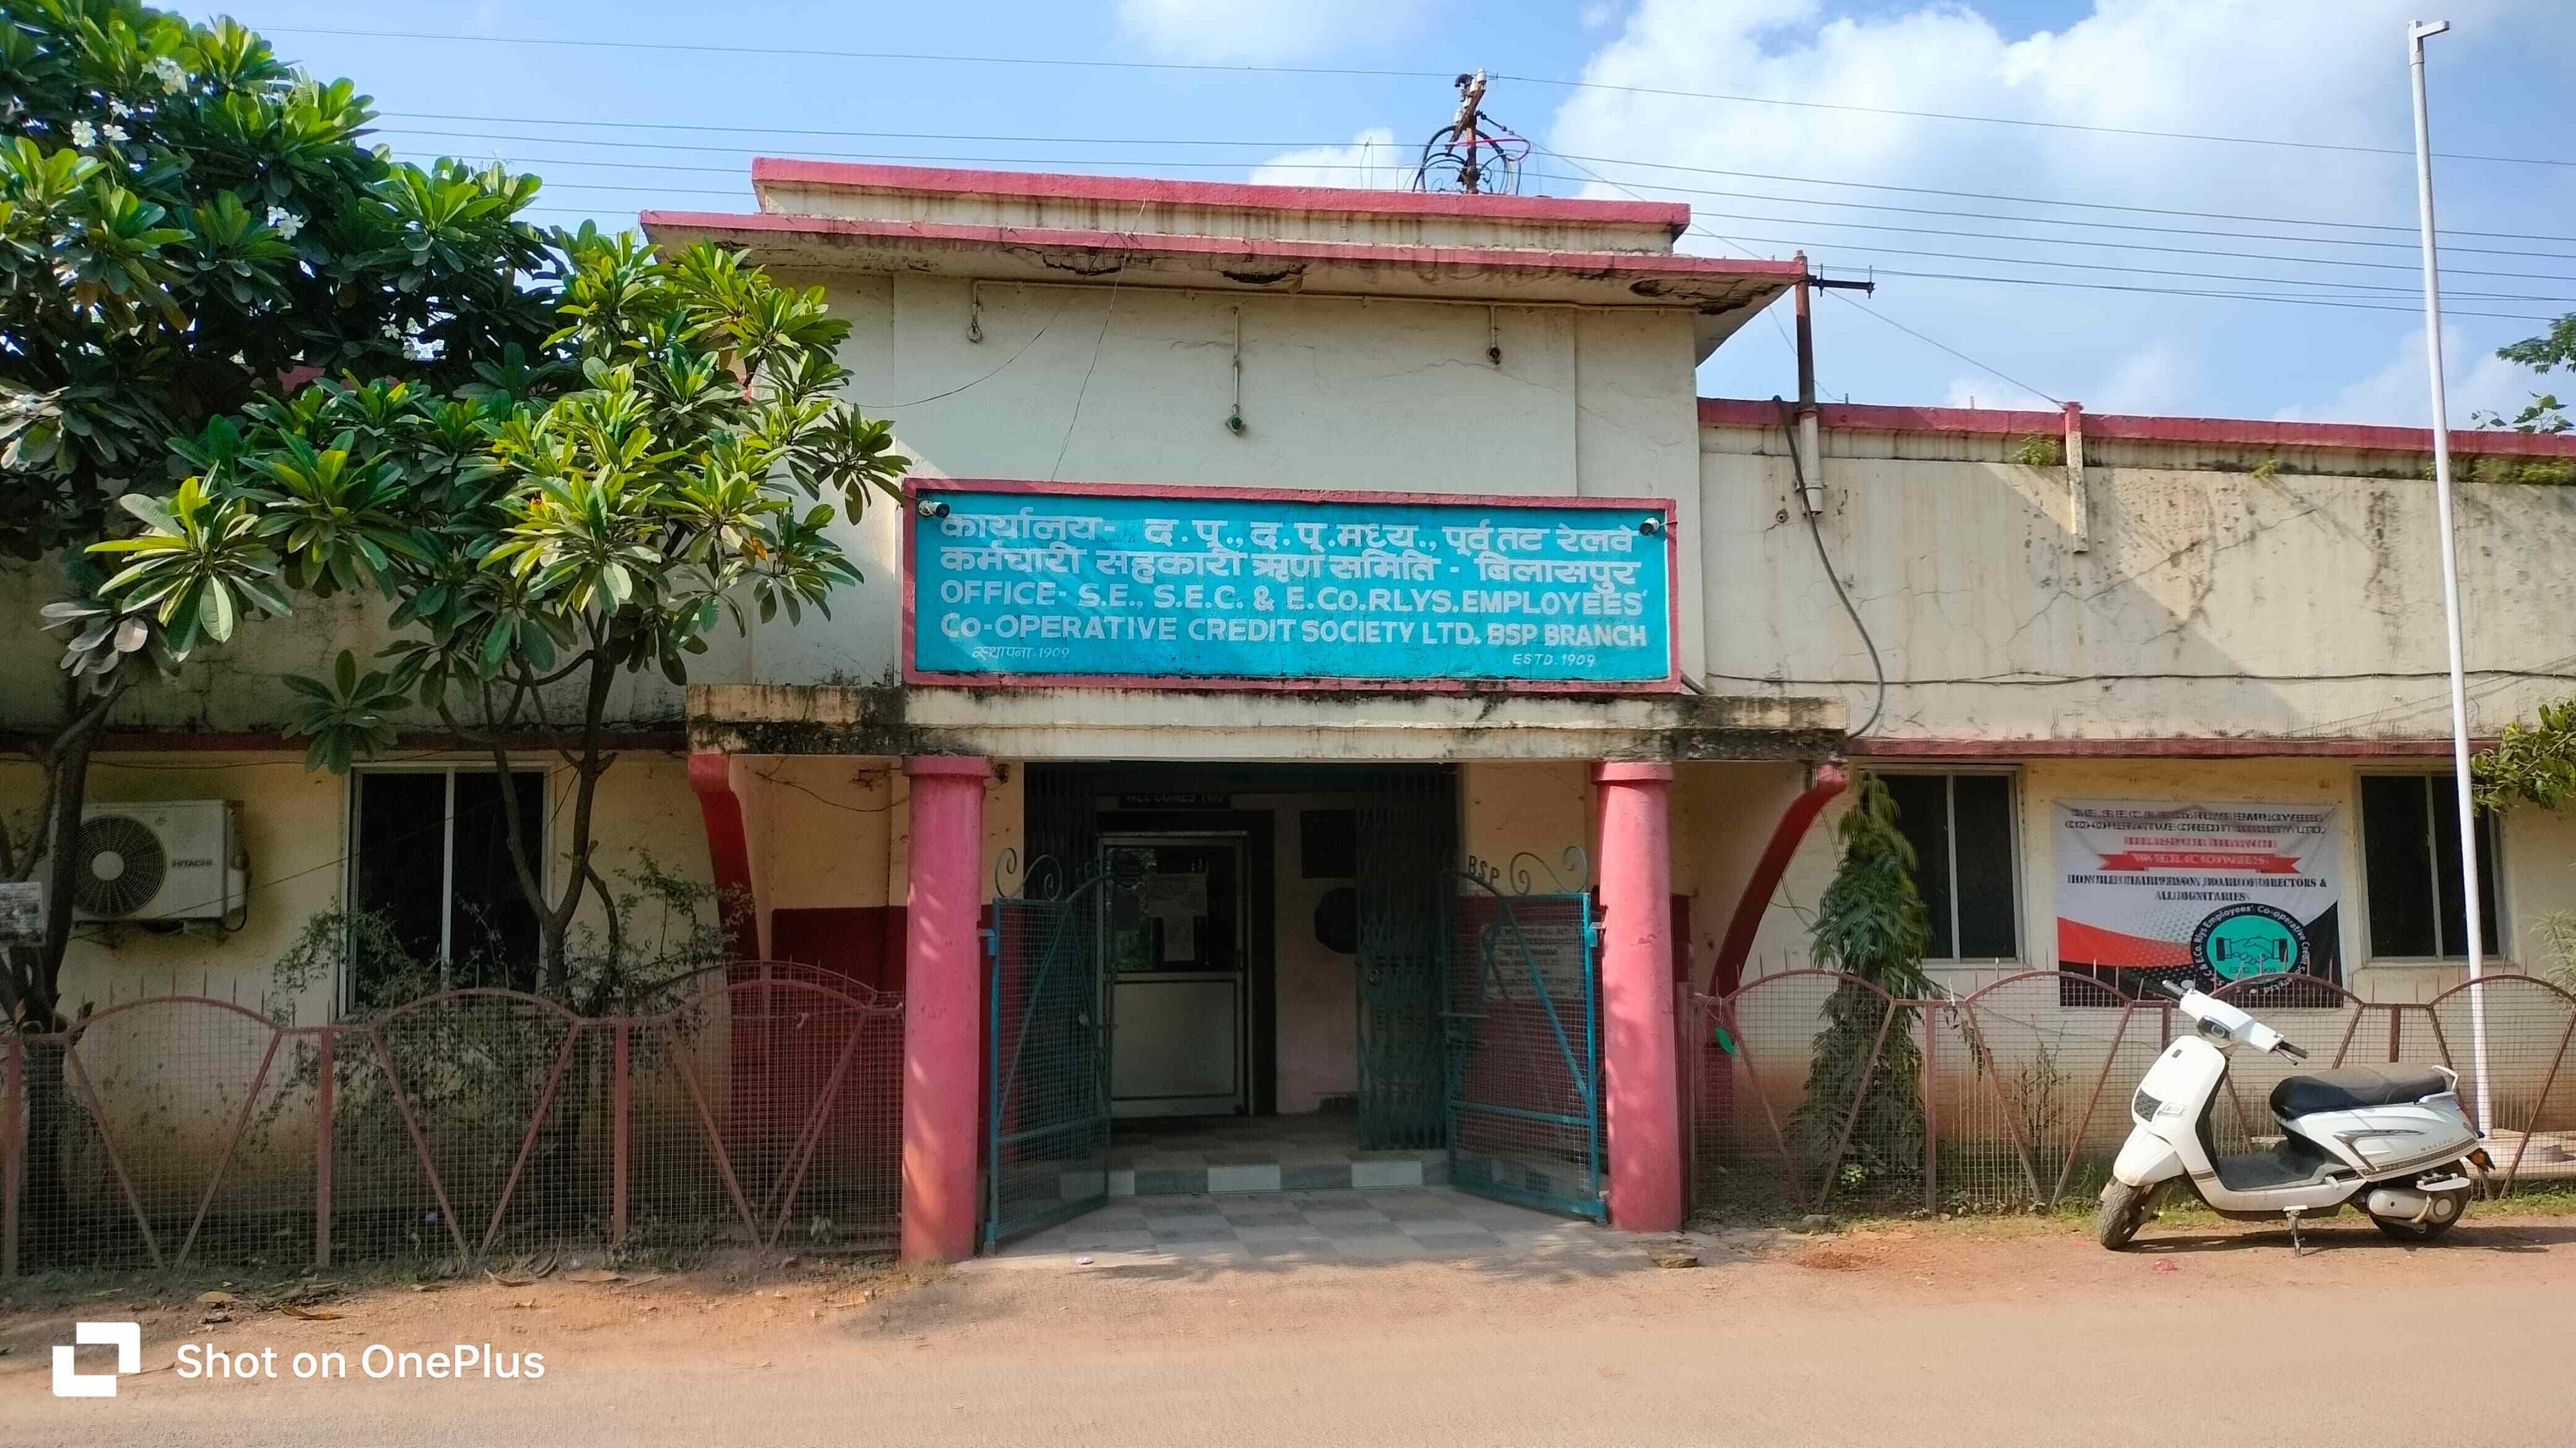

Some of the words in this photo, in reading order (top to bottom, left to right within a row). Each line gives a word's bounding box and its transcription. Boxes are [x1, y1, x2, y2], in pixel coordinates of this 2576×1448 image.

[1497, 527, 1550, 551] तट
[1556, 522, 1639, 552] रेलवे
[940, 540, 1087, 573] कर्मचारी
[1095, 547, 1248, 584] सहकारी
[1329, 548, 1442, 581] समिति
[1474, 551, 1642, 594] बिलासपुर
[1253, 586, 1274, 610] &
[1188, 618, 1296, 642] CREDIT
[1302, 620, 1414, 644] SOCIETY
[1422, 622, 1481, 645] LTD.
[1487, 623, 1538, 645] BSP
[1544, 624, 1647, 647] BRANCH
[172, 859, 212, 867] HITACHI
[2319, 878, 2327, 887] &
